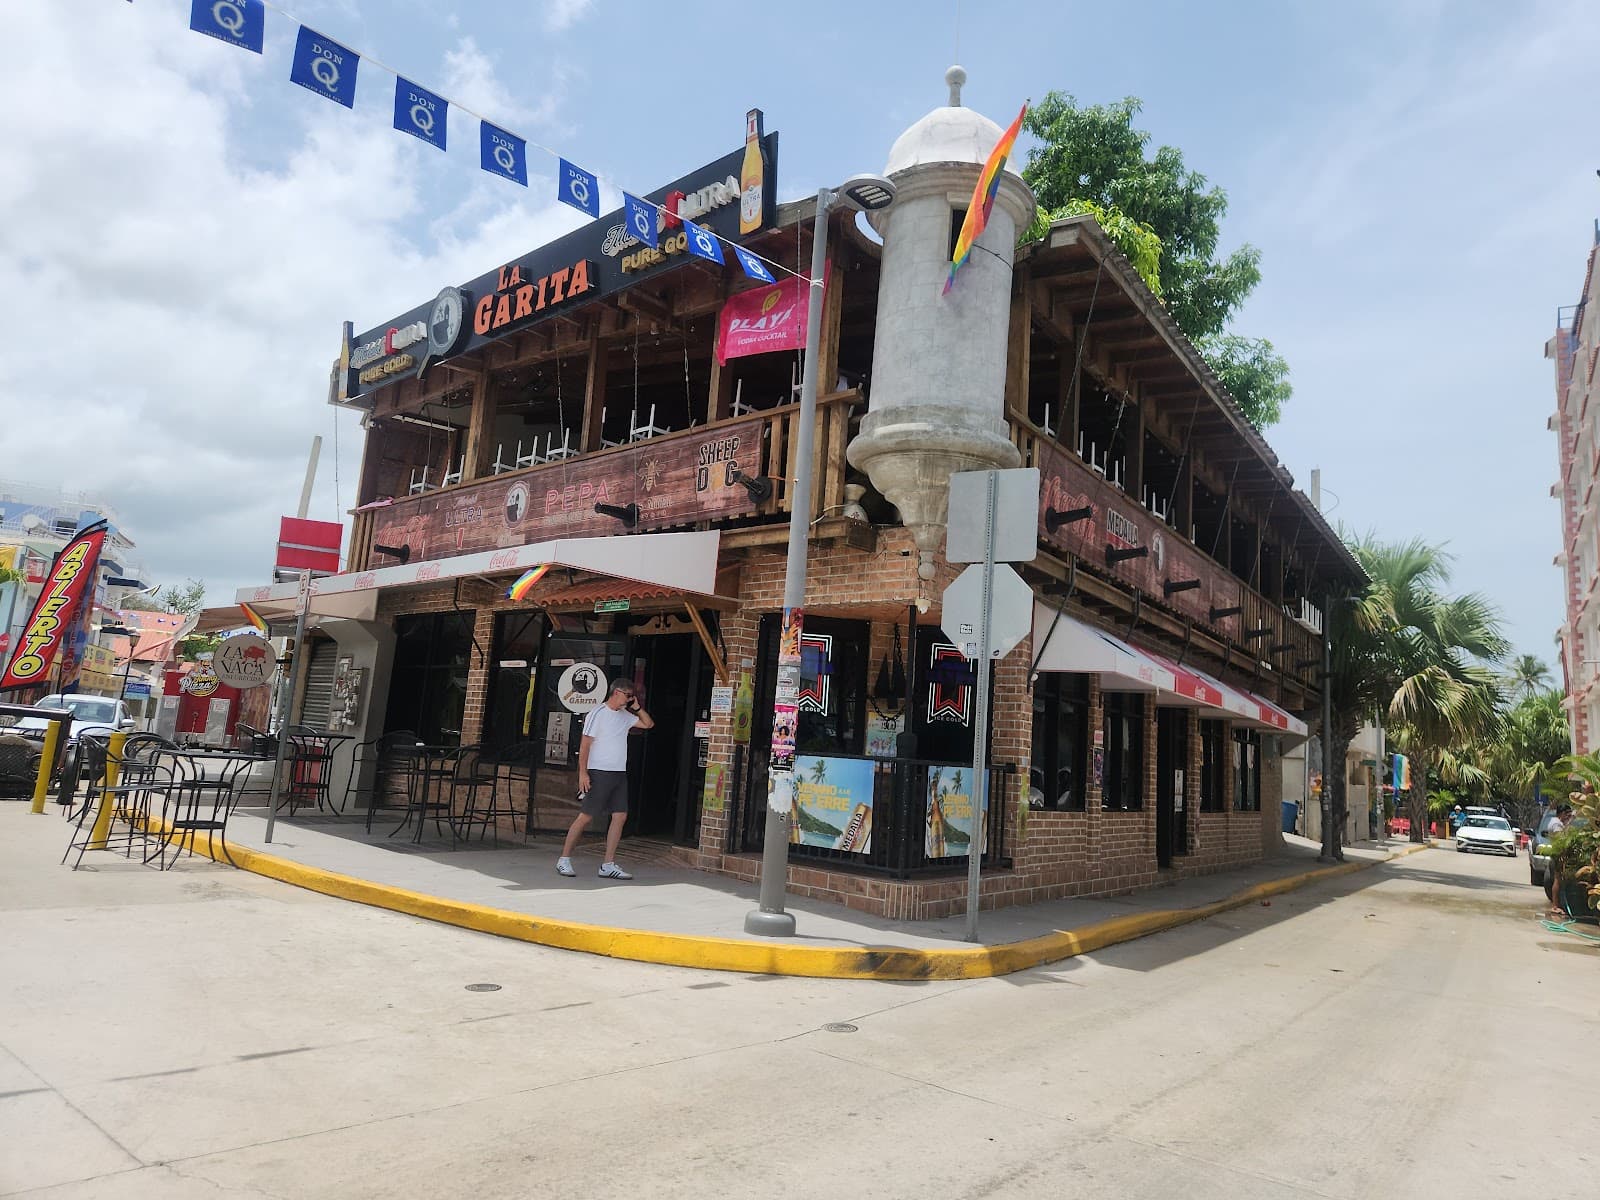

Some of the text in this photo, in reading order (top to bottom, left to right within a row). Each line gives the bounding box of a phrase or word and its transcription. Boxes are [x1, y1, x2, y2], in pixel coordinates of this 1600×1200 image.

[211, 1, 245, 38] Q
[312, 43, 343, 64] DON
[311, 57, 339, 92] Q
[408, 93, 436, 111] DON
[409, 105, 434, 137] Q
[492, 135, 515, 151] DON
[493, 145, 515, 175] Q
[569, 169, 589, 185] DON
[570, 179, 590, 207] Q
[632, 203, 648, 218] DON
[635, 213, 650, 239] Q
[695, 235, 714, 257] Q
[621, 247, 661, 273] PURE
[748, 259, 767, 278] Q
[496, 264, 520, 291] LA
[473, 258, 589, 335] GARITA
[758, 331, 787, 342] COCKTAIL
[699, 437, 740, 466] SHEEP
[545, 479, 610, 513] PEPA
[444, 505, 483, 528] ULTRA
[1107, 507, 1138, 548] MEDALLA
[11, 541, 92, 678] ABIERTO
[223, 646, 243, 659] LA
[221, 659, 264, 676] VACA
[180, 678, 211, 693] Pizza
[842, 812, 863, 851] MEDALLA
